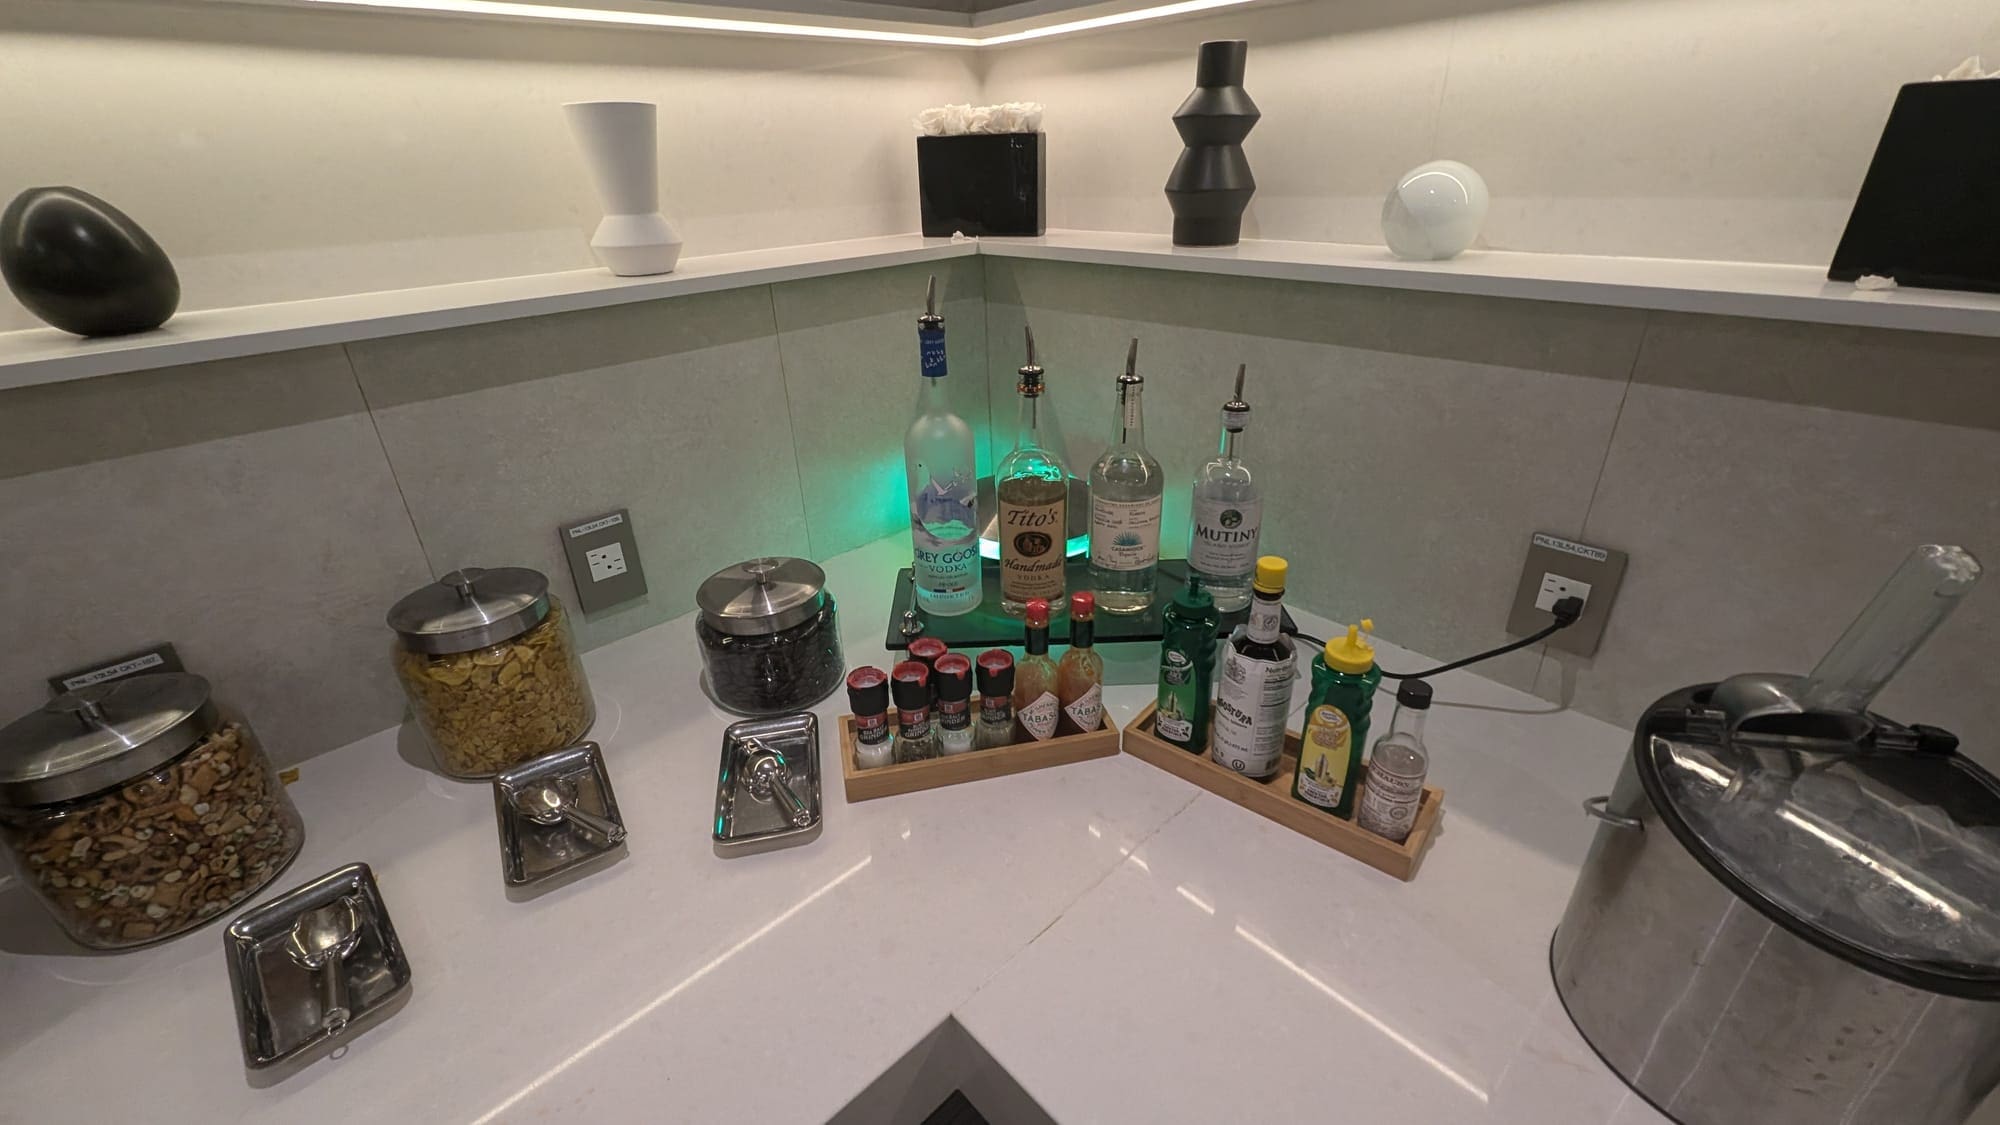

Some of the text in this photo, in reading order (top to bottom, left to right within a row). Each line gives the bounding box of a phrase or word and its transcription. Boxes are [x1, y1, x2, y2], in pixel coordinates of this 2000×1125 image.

[1007, 507, 1058, 527] Tito's
[1195, 523, 1258, 543] MUTINY
[942, 545, 978, 564] GOOS
[928, 563, 968, 574] VODKA
